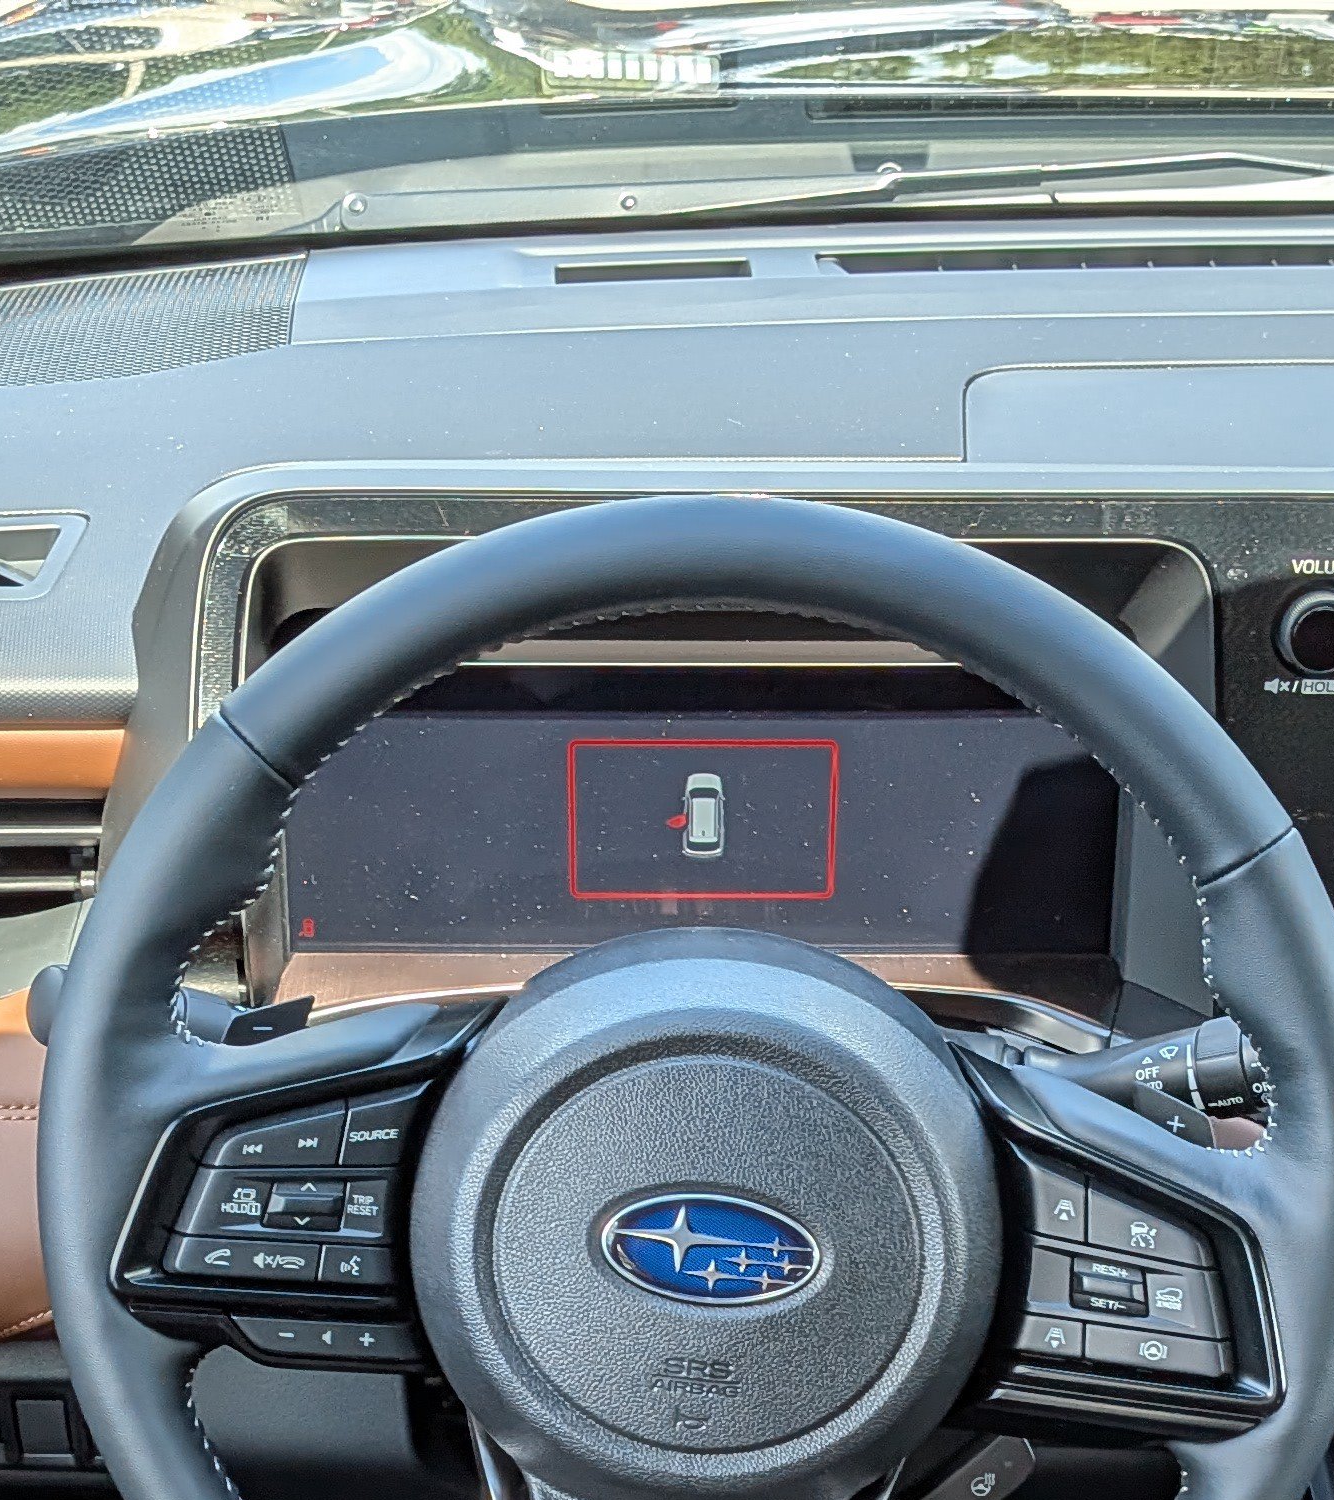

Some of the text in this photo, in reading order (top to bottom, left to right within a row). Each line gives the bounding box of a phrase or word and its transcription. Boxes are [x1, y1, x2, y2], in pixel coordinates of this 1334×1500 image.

[1135, 1066, 1160, 1081] OFF
[1217, 1096, 1243, 1107] AUTO
[349, 1128, 399, 1142] SOURCE
[352, 1194, 374, 1205] TRIP
[221, 1202, 250, 1214] HOLD
[346, 1204, 379, 1217] RESET
[663, 1357, 732, 1378] SRS
[652, 1379, 740, 1396] AIRBAG
